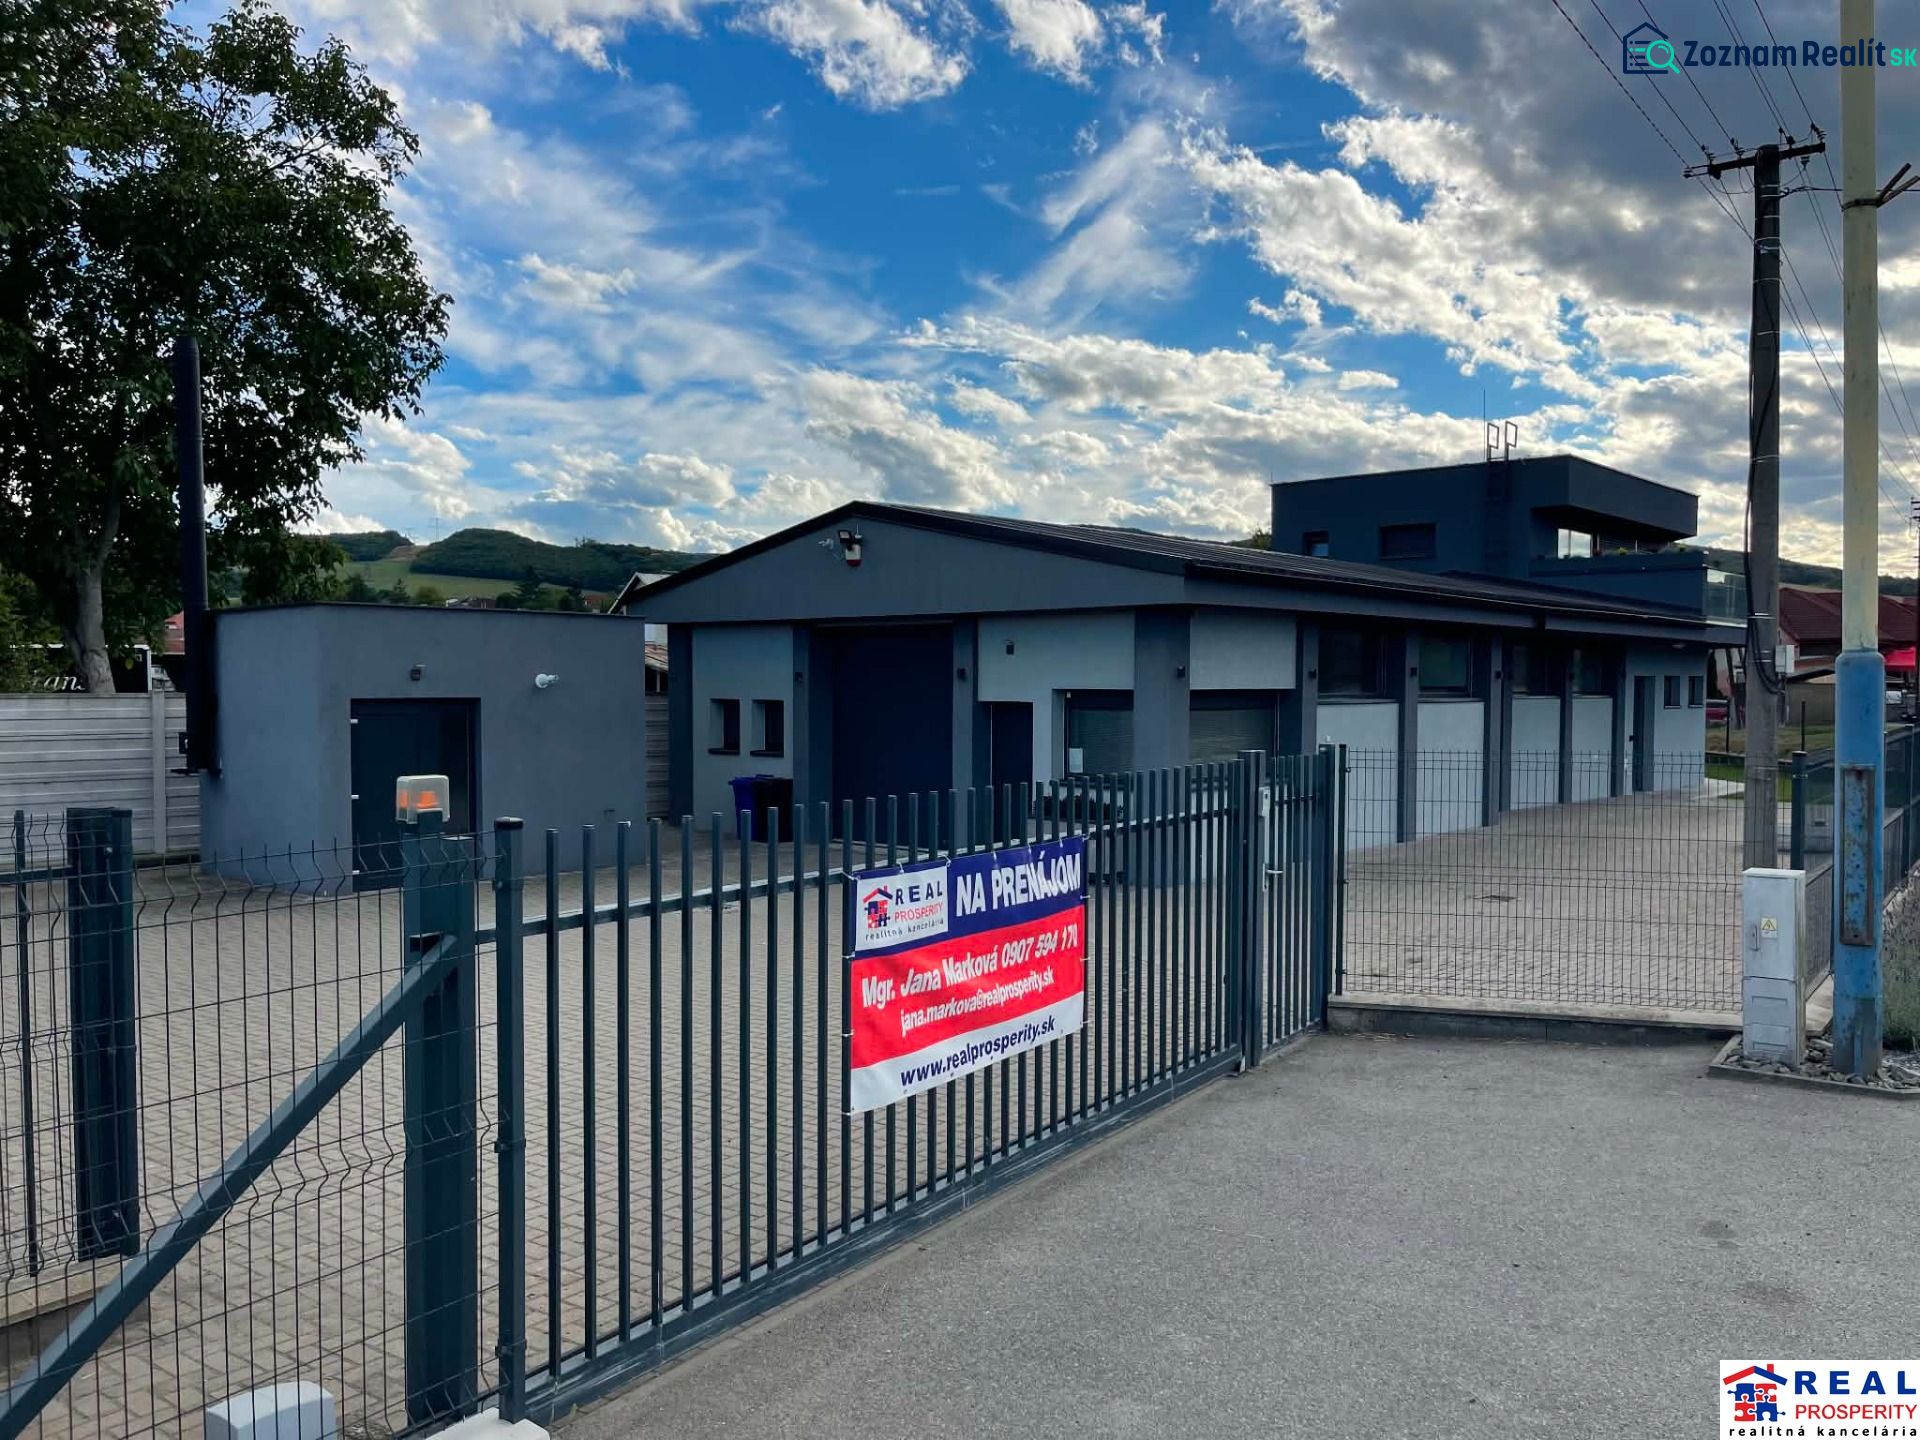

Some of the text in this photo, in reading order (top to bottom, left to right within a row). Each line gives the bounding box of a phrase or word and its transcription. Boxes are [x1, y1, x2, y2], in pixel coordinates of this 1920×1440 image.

[894, 902, 944, 923] PROSPERITY
[895, 880, 943, 906] REAL
[956, 851, 1081, 917] NA PRENÁJOM
[862, 976, 896, 1010] Mgr.
[901, 968, 941, 997] Jana
[942, 944, 998, 987] Marková
[1001, 937, 1035, 969] 0907
[1034, 930, 1059, 958] 594
[900, 966, 1055, 1038] jana.markova@realprosperity.sk
[900, 1015, 1055, 1087] www.realprosperity.sk
